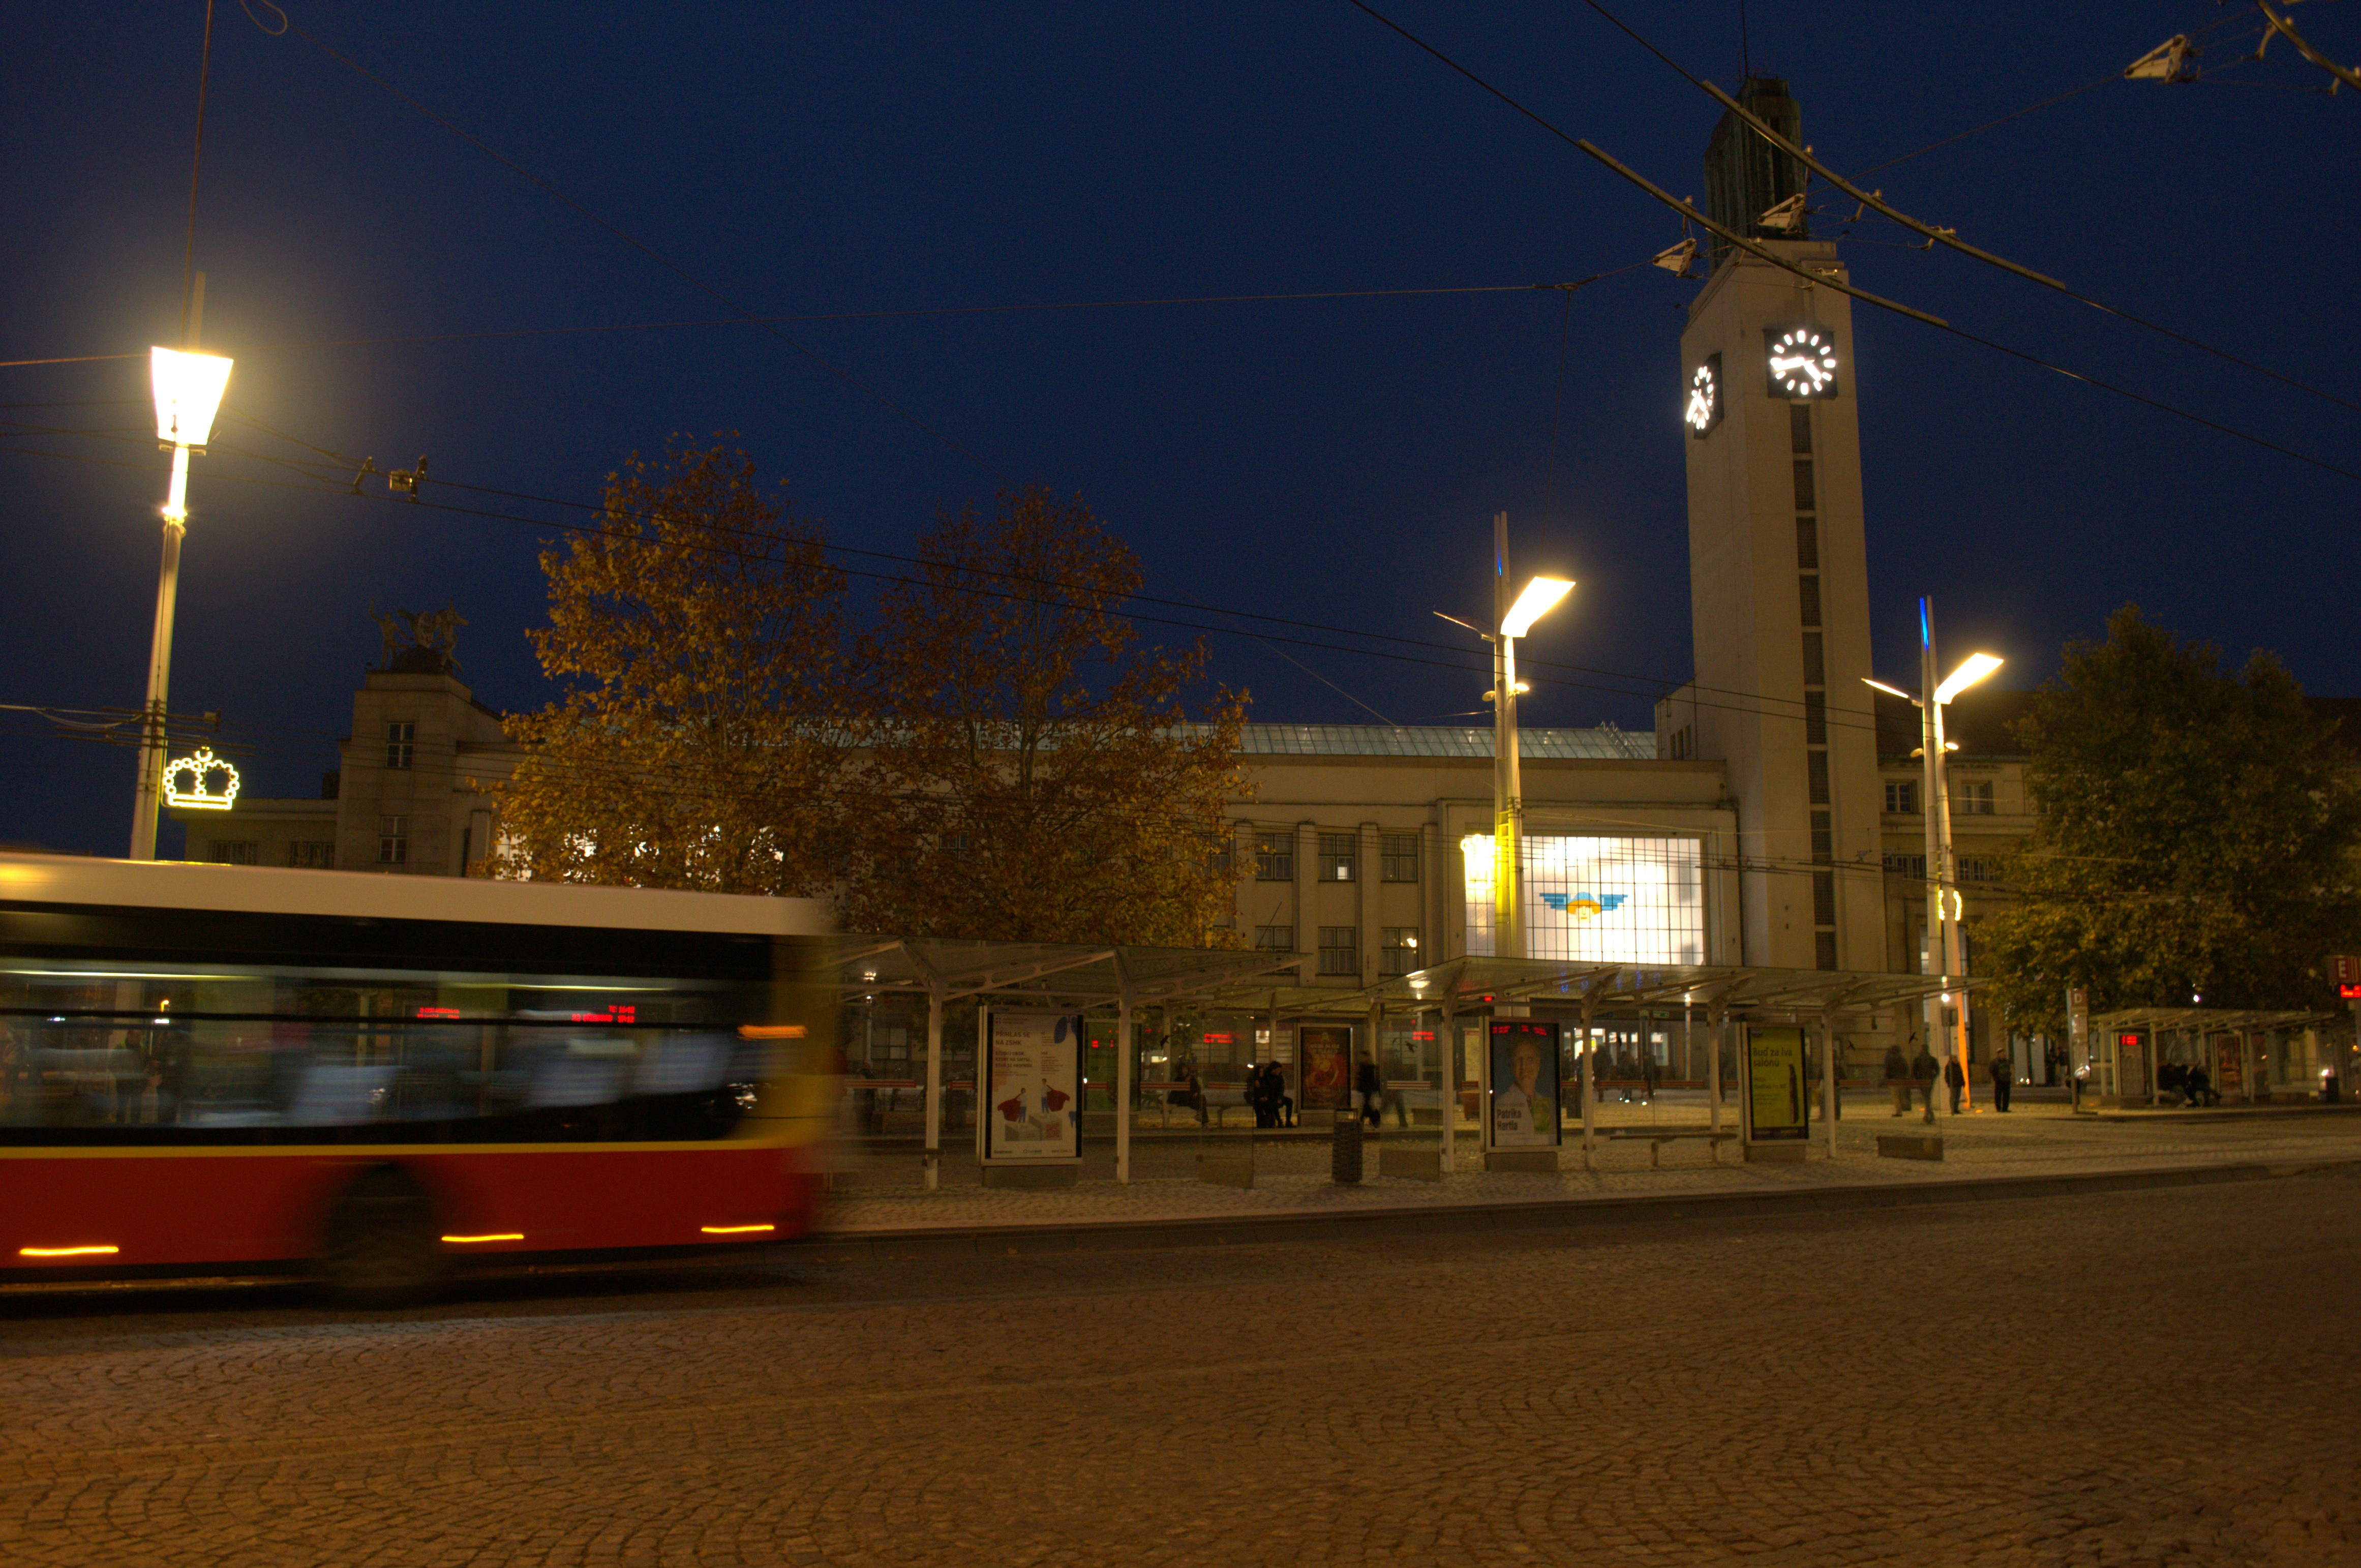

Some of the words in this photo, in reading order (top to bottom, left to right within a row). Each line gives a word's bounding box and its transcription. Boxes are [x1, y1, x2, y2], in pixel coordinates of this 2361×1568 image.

[2338, 960, 2347, 978] E
[2074, 993, 2082, 1004] D
[1752, 1046, 1769, 1056] Buď
[1497, 1108, 1522, 1119] Patrika
[1497, 1120, 1518, 1131] Hartla
